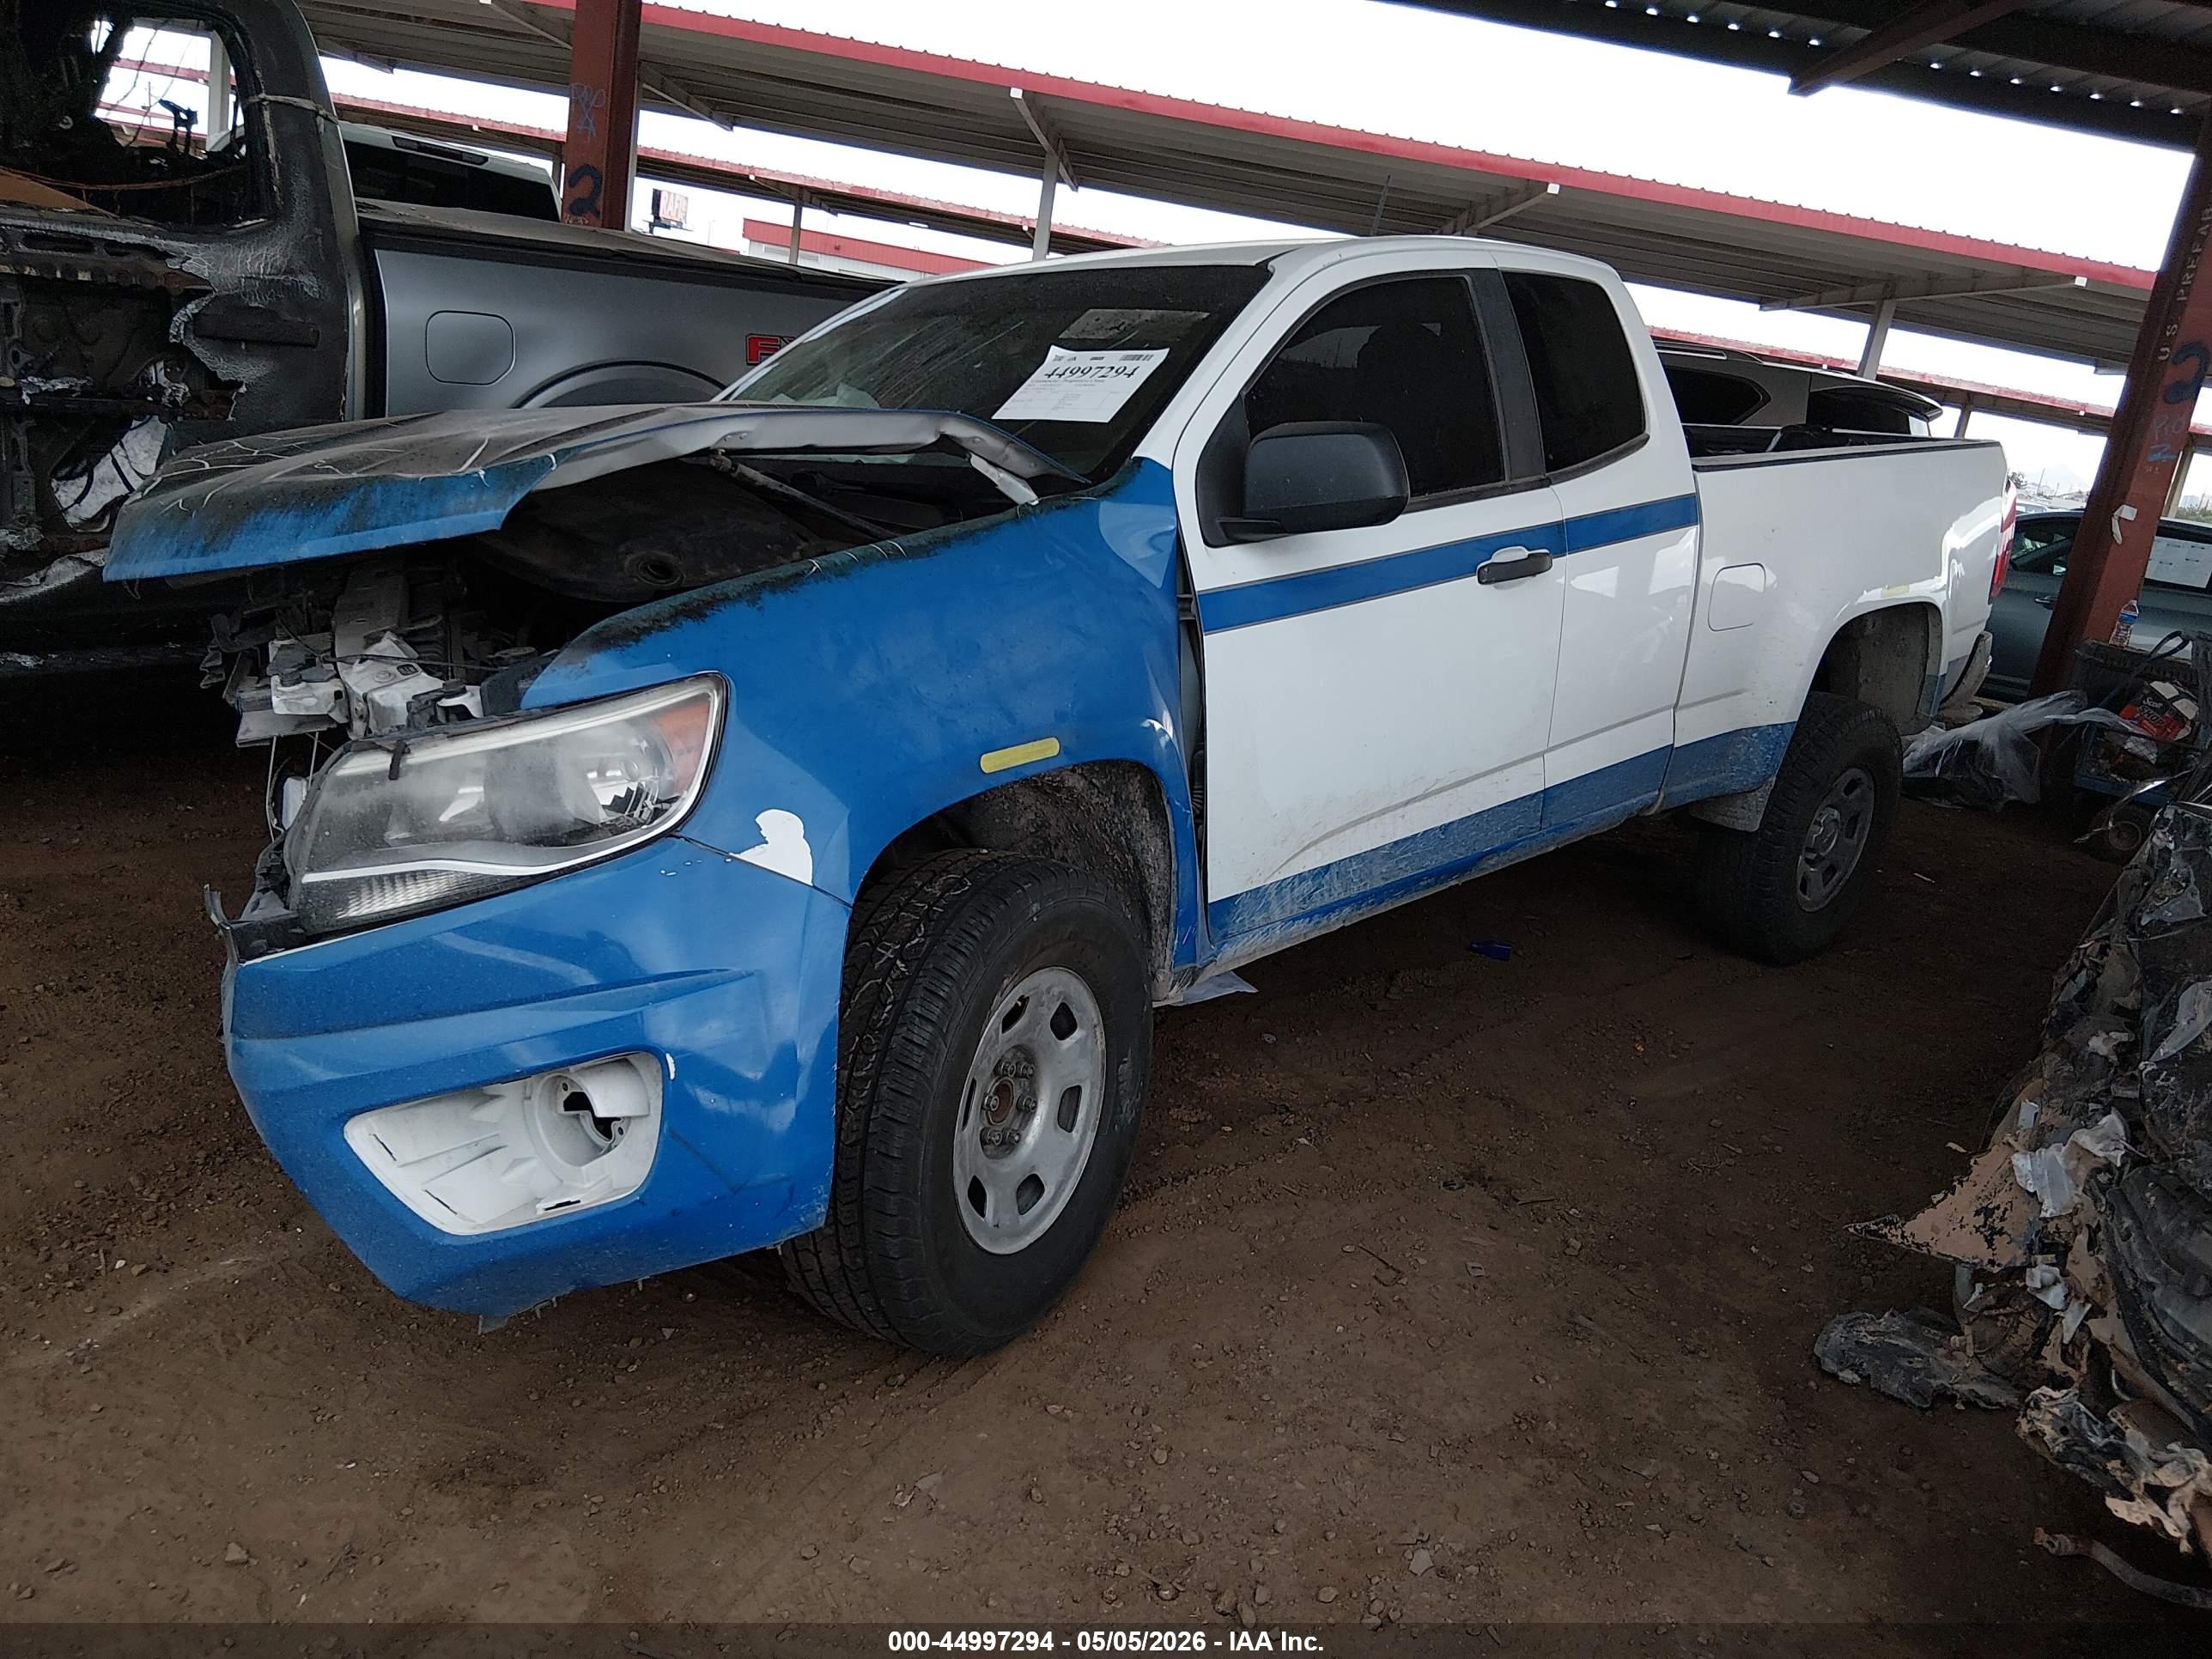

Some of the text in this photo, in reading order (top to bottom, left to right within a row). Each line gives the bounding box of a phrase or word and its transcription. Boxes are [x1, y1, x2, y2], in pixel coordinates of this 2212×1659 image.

[568, 164, 603, 218] 2
[1044, 365, 1140, 380] 44997294
[2164, 341, 2210, 405] 2
